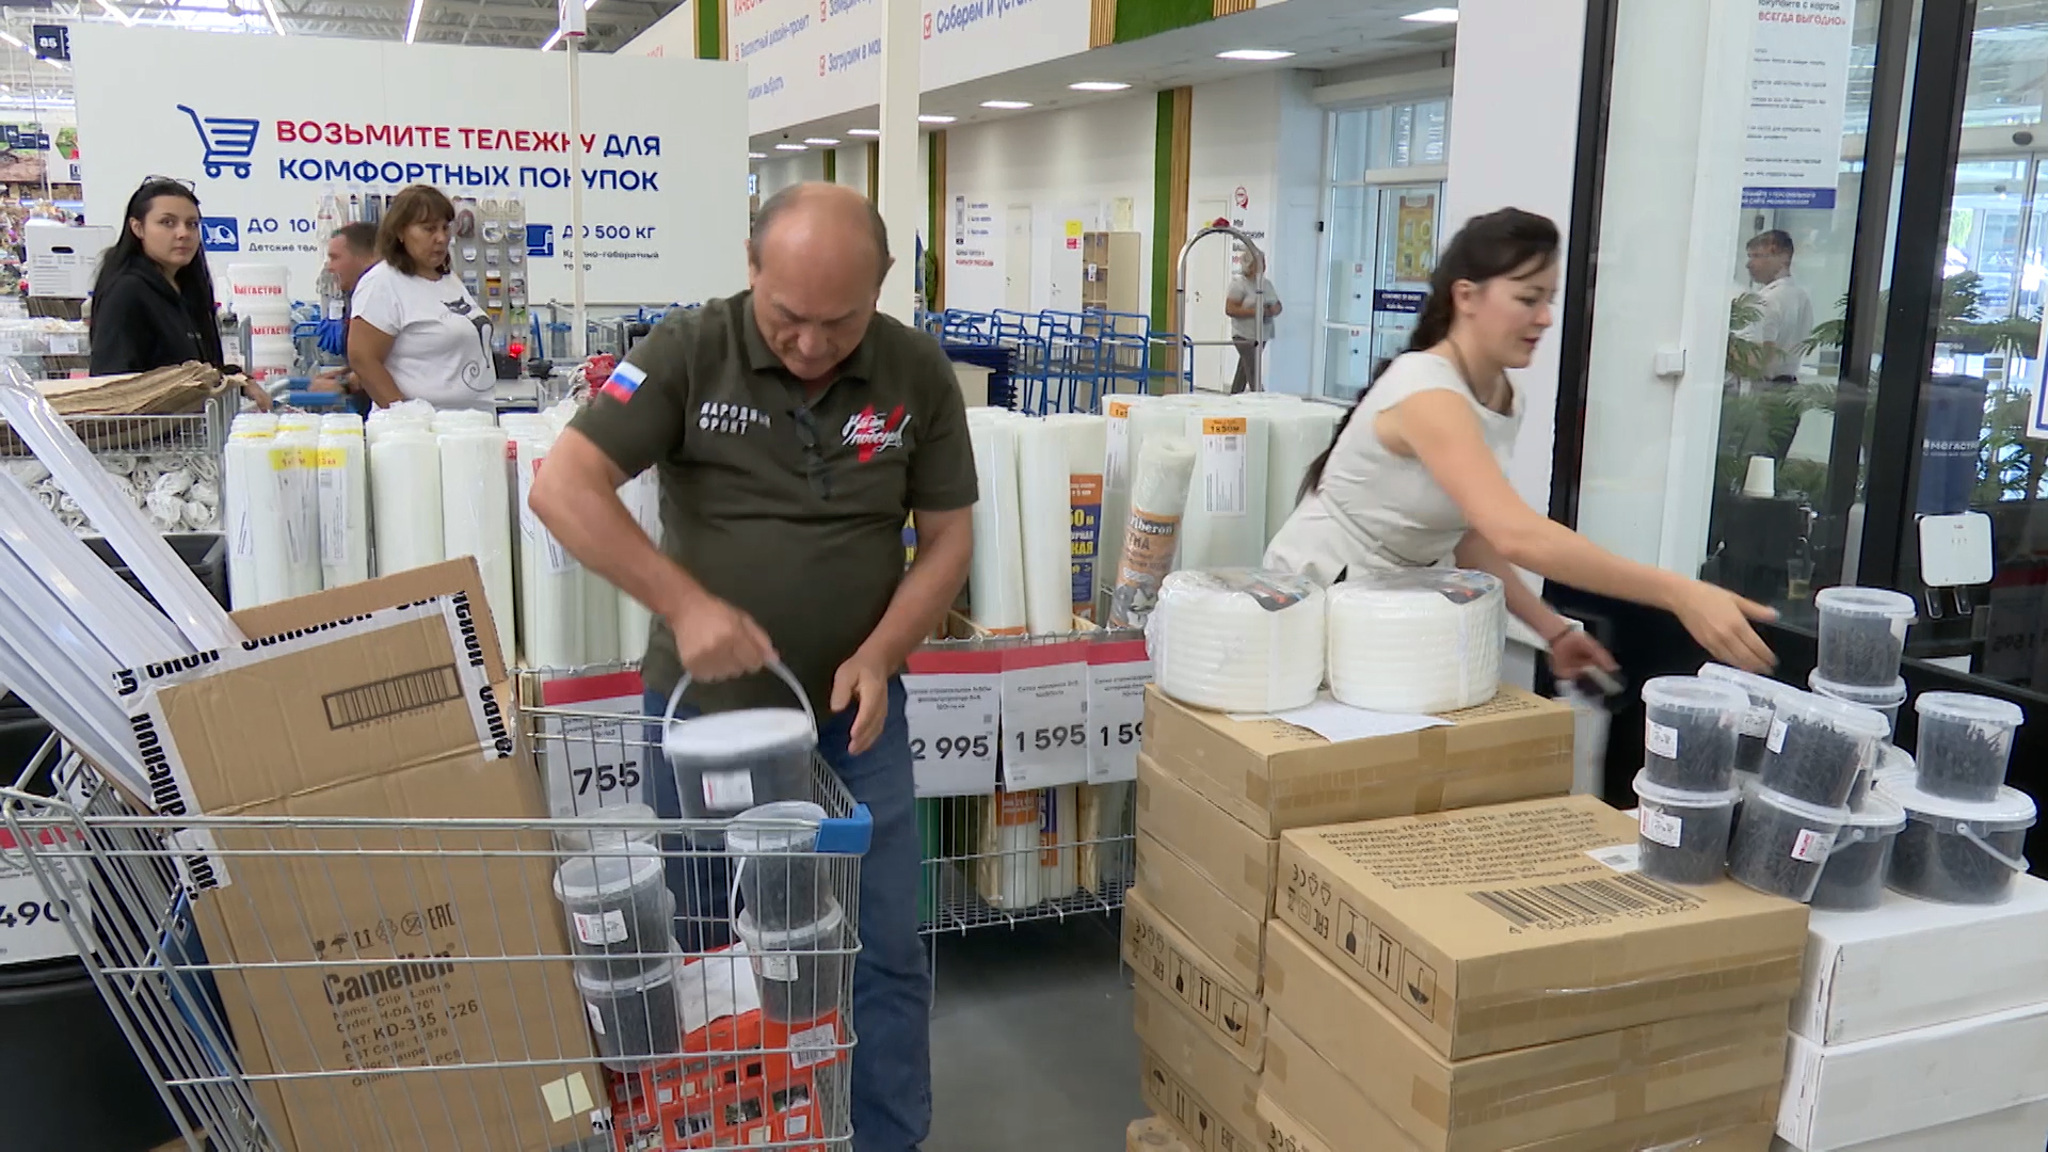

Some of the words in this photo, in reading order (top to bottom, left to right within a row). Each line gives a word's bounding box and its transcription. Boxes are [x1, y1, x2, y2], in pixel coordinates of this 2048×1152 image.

[936, 2, 984, 34] Соберем
[276, 120, 451, 149] ВОЗЬМИТЕ
[603, 134, 661, 158] ДЛЯ
[279, 158, 510, 187] КОМФОРТНЫХ
[247, 218, 279, 234] ДО
[595, 225, 631, 239] 500
[636, 226, 657, 239] КГ
[699, 416, 749, 435] ФРОНТ
[910, 738, 926, 761] 2
[935, 735, 990, 760] 995
[1016, 731, 1026, 753] 1
[1035, 724, 1087, 751] 595
[1100, 725, 1109, 747] 1
[573, 761, 640, 796] 755
[376, 994, 402, 1008] Clip
[373, 1012, 437, 1041] KD-335
[446, 1000, 479, 1020] C26
